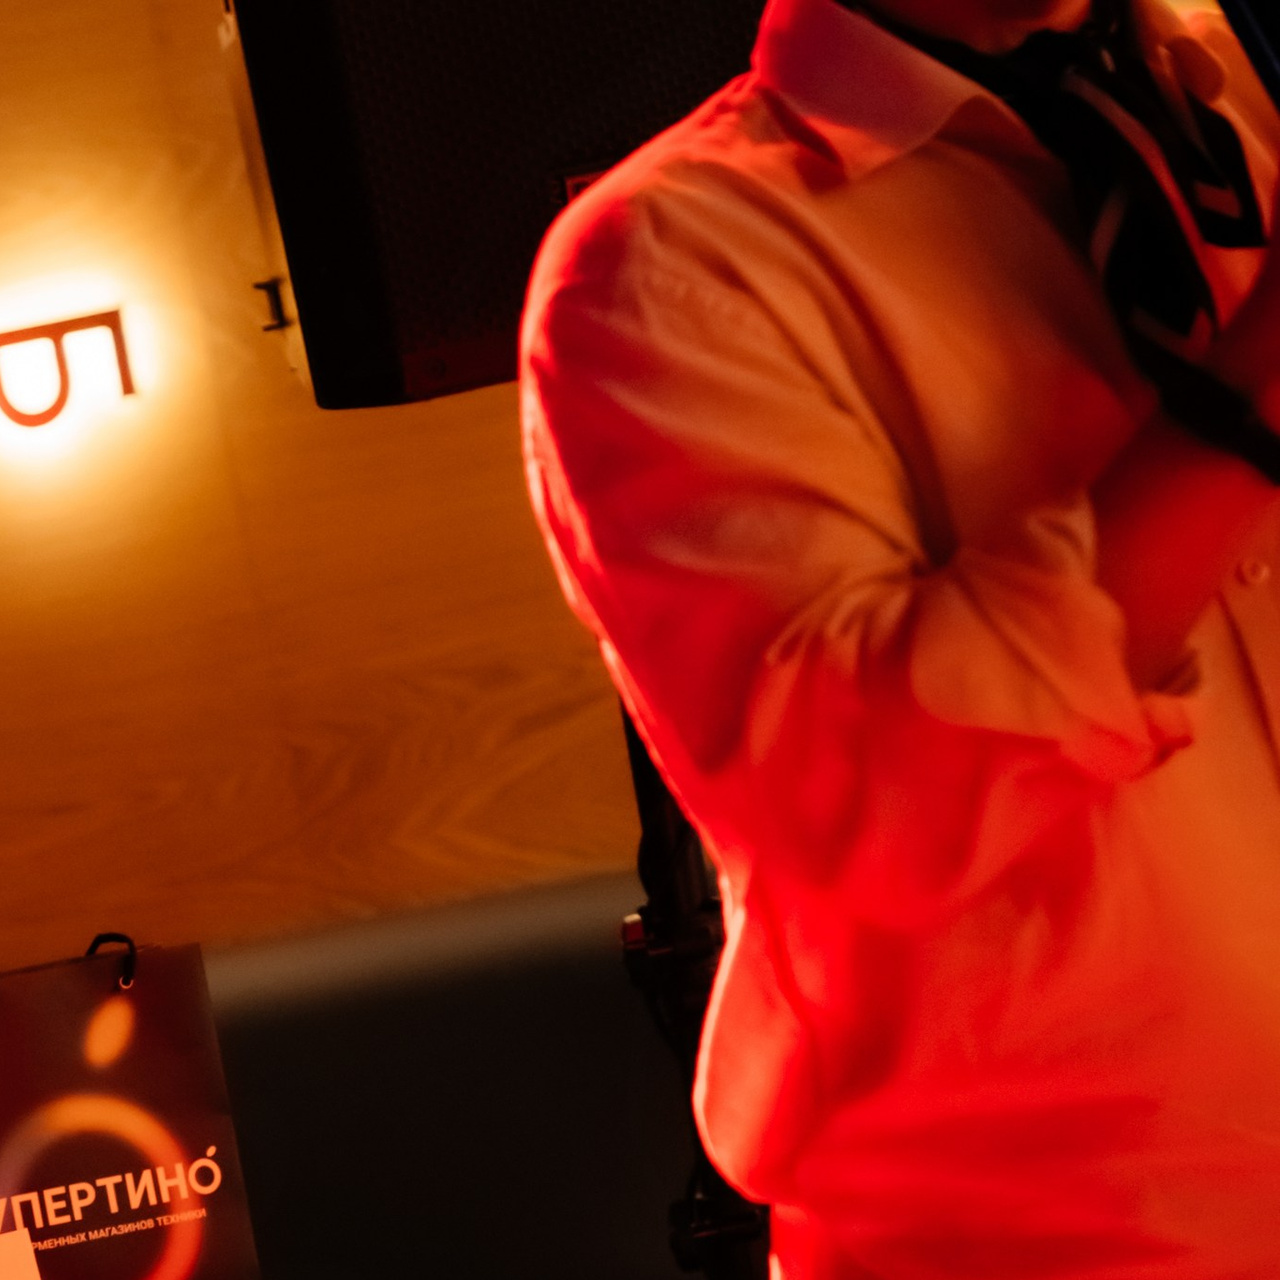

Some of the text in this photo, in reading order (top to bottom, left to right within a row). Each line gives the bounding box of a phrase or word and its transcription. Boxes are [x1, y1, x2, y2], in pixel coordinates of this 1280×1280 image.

[30, 1208, 207, 1252] РМЕННЫХ МАГАЗИНОВ ТЕХНИКИ
